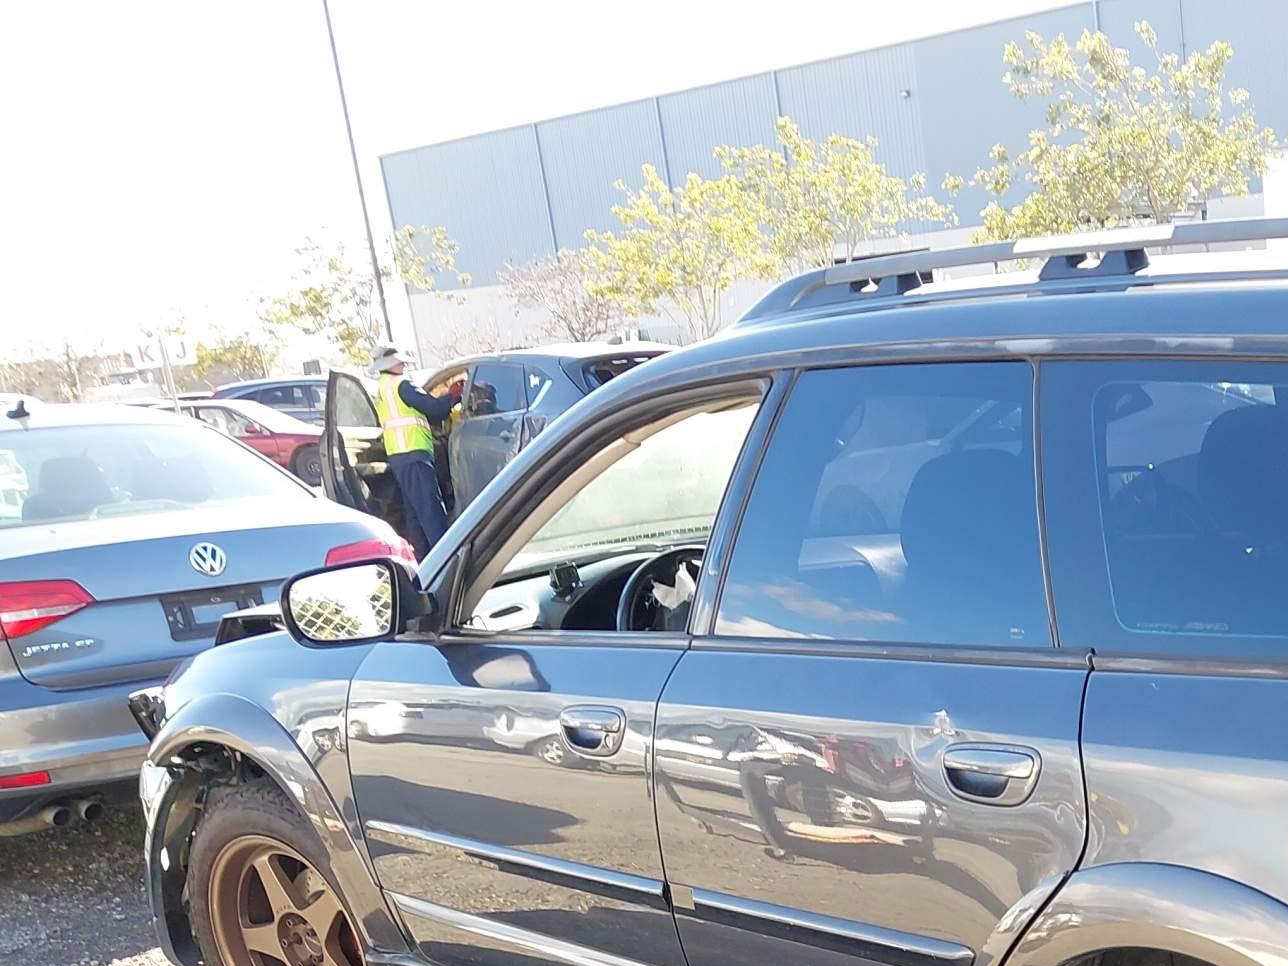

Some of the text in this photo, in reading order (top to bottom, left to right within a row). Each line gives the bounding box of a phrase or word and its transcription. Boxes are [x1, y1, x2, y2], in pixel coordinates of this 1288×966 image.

[137, 345, 155, 363] K
[176, 341, 187, 360] J
[22, 642, 70, 657] JETTA
